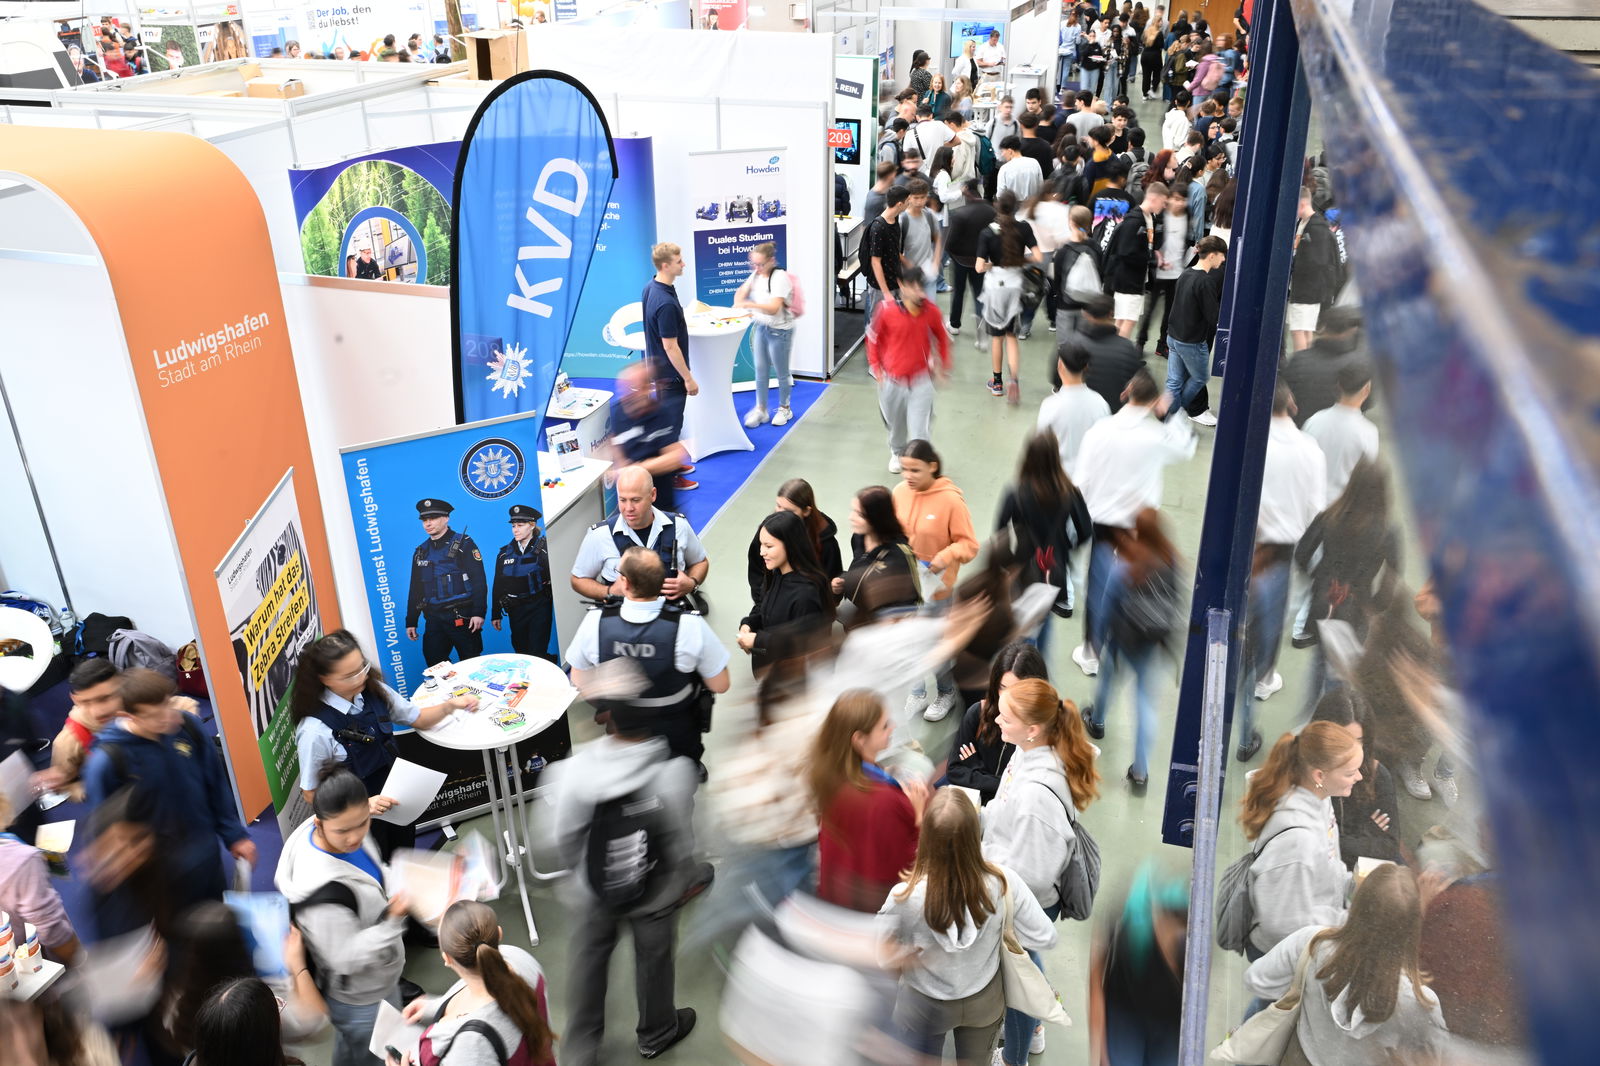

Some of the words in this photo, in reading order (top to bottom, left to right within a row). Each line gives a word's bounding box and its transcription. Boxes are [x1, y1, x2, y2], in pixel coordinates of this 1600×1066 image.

[317, 9, 329, 18] Der
[332, 6, 350, 16] Job,
[352, 5, 372, 14] den
[318, 19, 328, 29] du
[330, 16, 360, 27] liebst!
[840, 84, 860, 95] REIN.
[828, 131, 851, 144] 209
[746, 166, 780, 174] Howden
[506, 158, 588, 318] KVD
[708, 235, 738, 245] Duales
[738, 232, 774, 242] Studium
[596, 244, 607, 252] für
[718, 246, 731, 255] bei
[152, 312, 270, 370] Ludwigshafen
[158, 362, 196, 388] Stadt
[200, 354, 222, 372] am
[224, 336, 262, 360] Rhein
[356, 458, 382, 554] Ludwigshafen
[246, 603, 275, 647] Warum
[274, 582, 287, 606] hat
[286, 560, 300, 582] das
[372, 554, 400, 648] Vollzugsdienst
[253, 642, 276, 682] Zebra
[276, 586, 308, 645] Streifen?
[613, 640, 656, 658] KVD
[442, 797, 456, 808] am
[458, 790, 482, 801] Rhein
